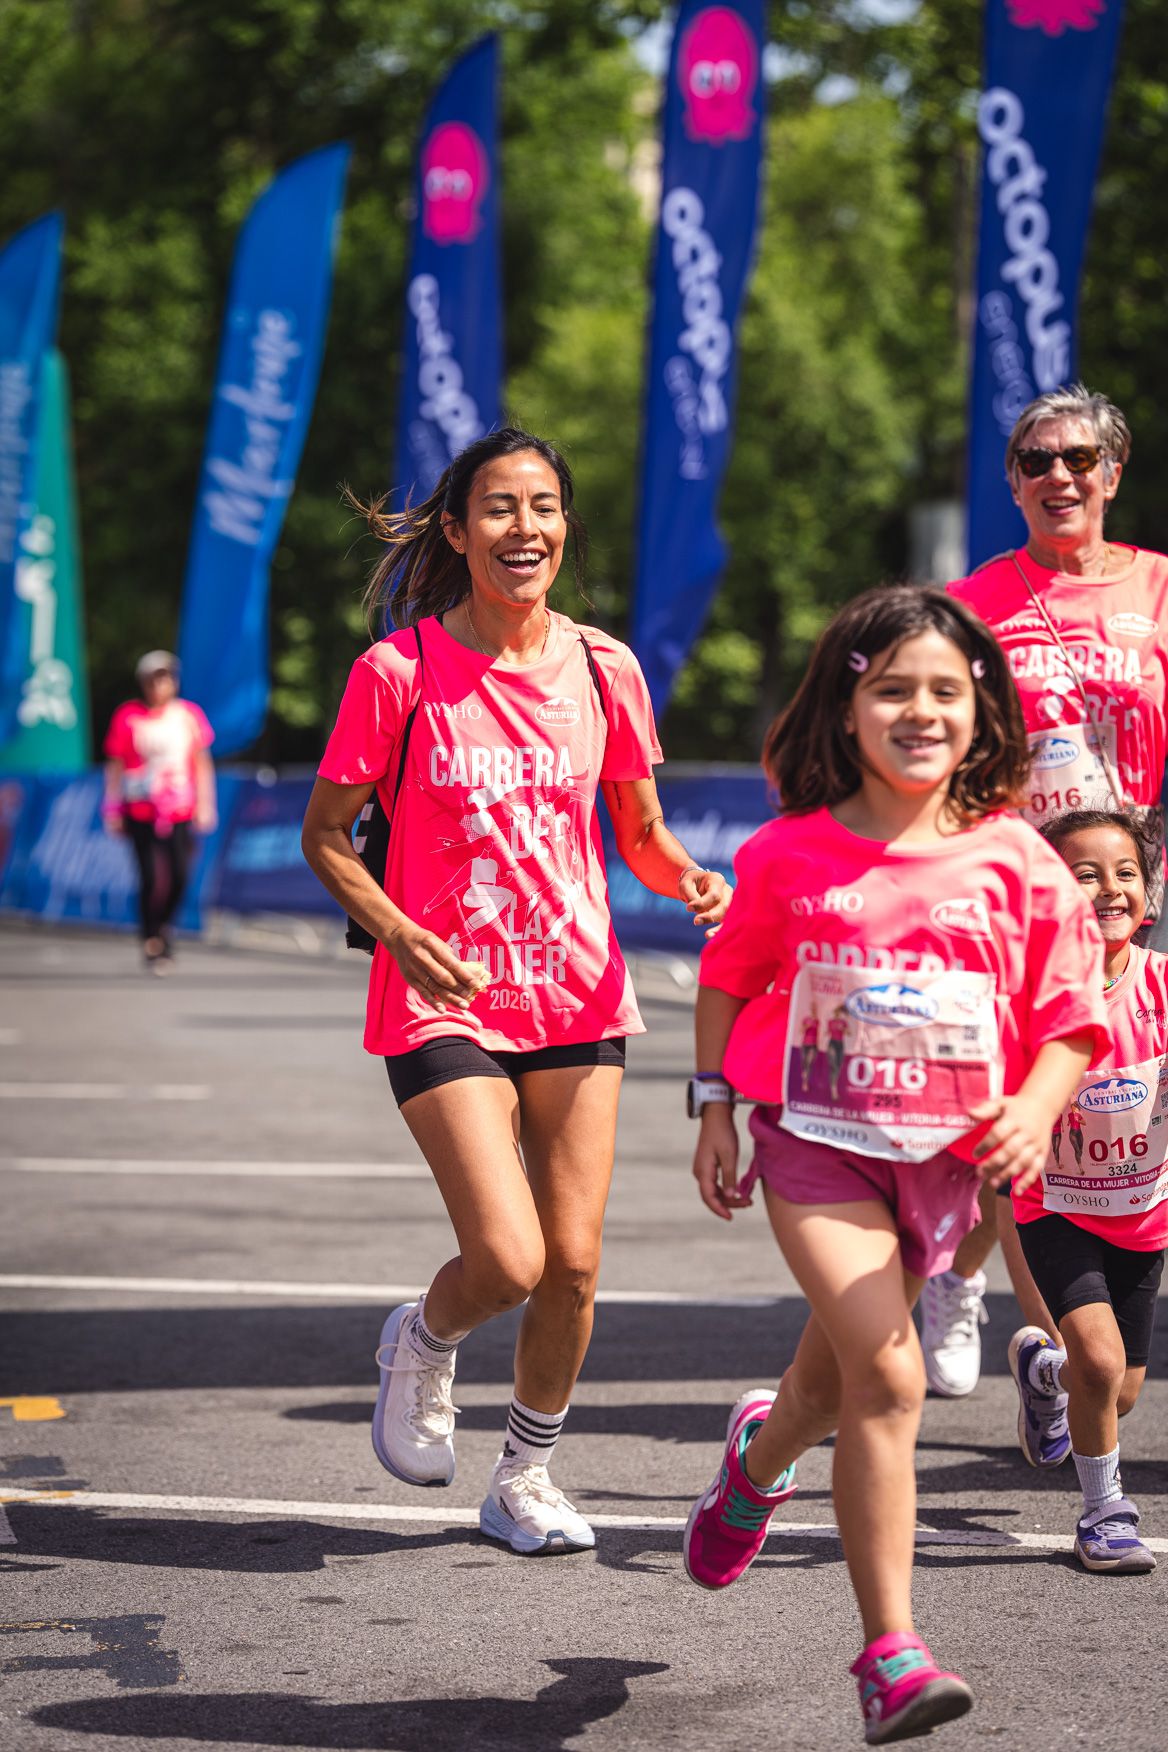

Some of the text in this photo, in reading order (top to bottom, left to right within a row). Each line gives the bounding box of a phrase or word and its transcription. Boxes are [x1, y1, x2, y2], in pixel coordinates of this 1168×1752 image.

[1008, 644, 1143, 684] CARRERA
[430, 744, 575, 787] CARRERA
[1031, 788, 1082, 813] 016
[511, 803, 555, 859] DE
[506, 894, 543, 940] LA
[489, 988, 531, 1012] 2026
[847, 1056, 928, 1090] 016
[1083, 1089, 1144, 1107] ASTURIANA
[1088, 1133, 1149, 1163] 016
[1048, 1176, 1080, 1188] CARRERA
[1081, 1180, 1091, 1188] DE
[1092, 1181, 1101, 1189] LA
[1103, 1178, 1130, 1189] MUJER
[1108, 1163, 1138, 1177] 3324
[1063, 1193, 1110, 1208] OYSHO
